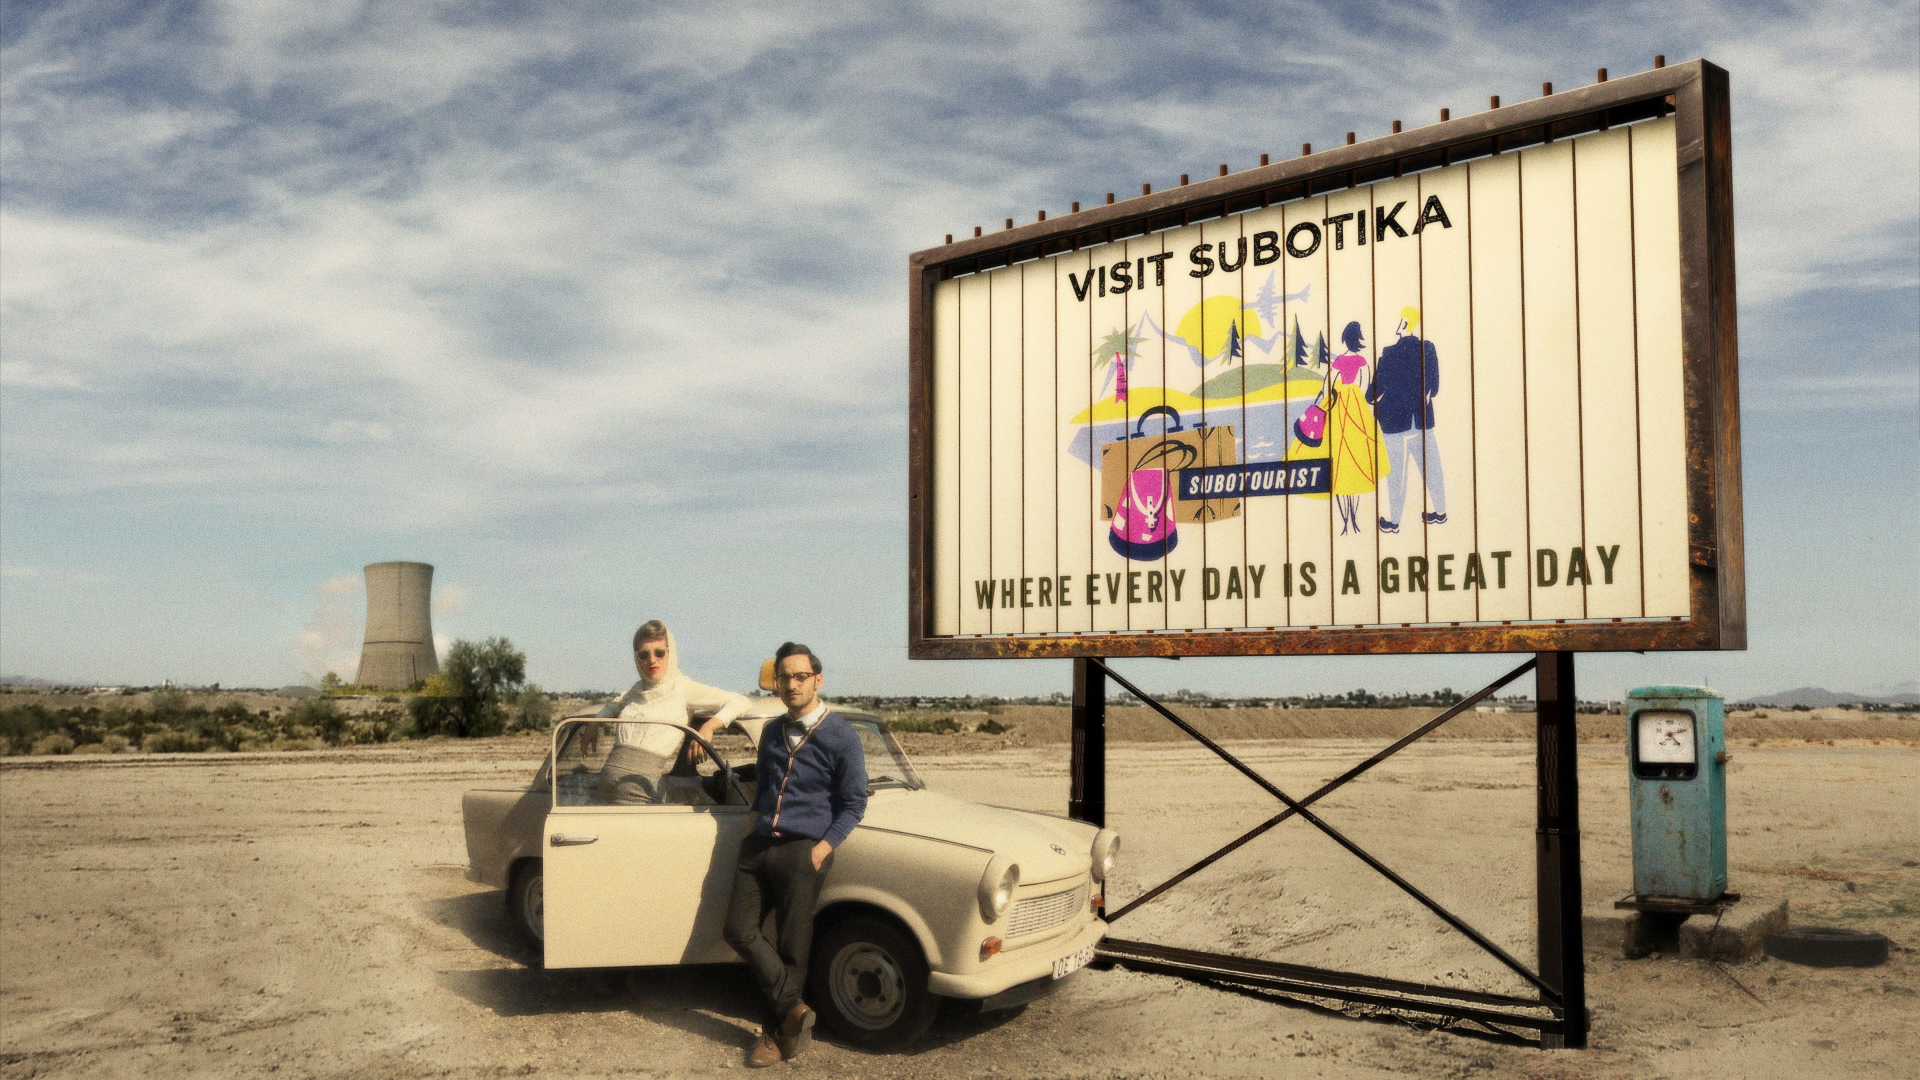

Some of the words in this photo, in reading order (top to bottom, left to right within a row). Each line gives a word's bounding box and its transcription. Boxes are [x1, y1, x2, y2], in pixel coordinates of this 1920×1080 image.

[1068, 251, 1174, 302] VISIT
[1188, 194, 1453, 279] SUBOTIKA
[1189, 467, 1322, 494] SUBOTOURIST
[975, 575, 1072, 610] WHERE
[1086, 569, 1186, 605] EVERY
[1202, 564, 1266, 601] DAY
[1283, 561, 1317, 597] IS
[1341, 559, 1361, 595] A
[1380, 550, 1512, 594] GREAT
[1536, 544, 1621, 588] DAY
